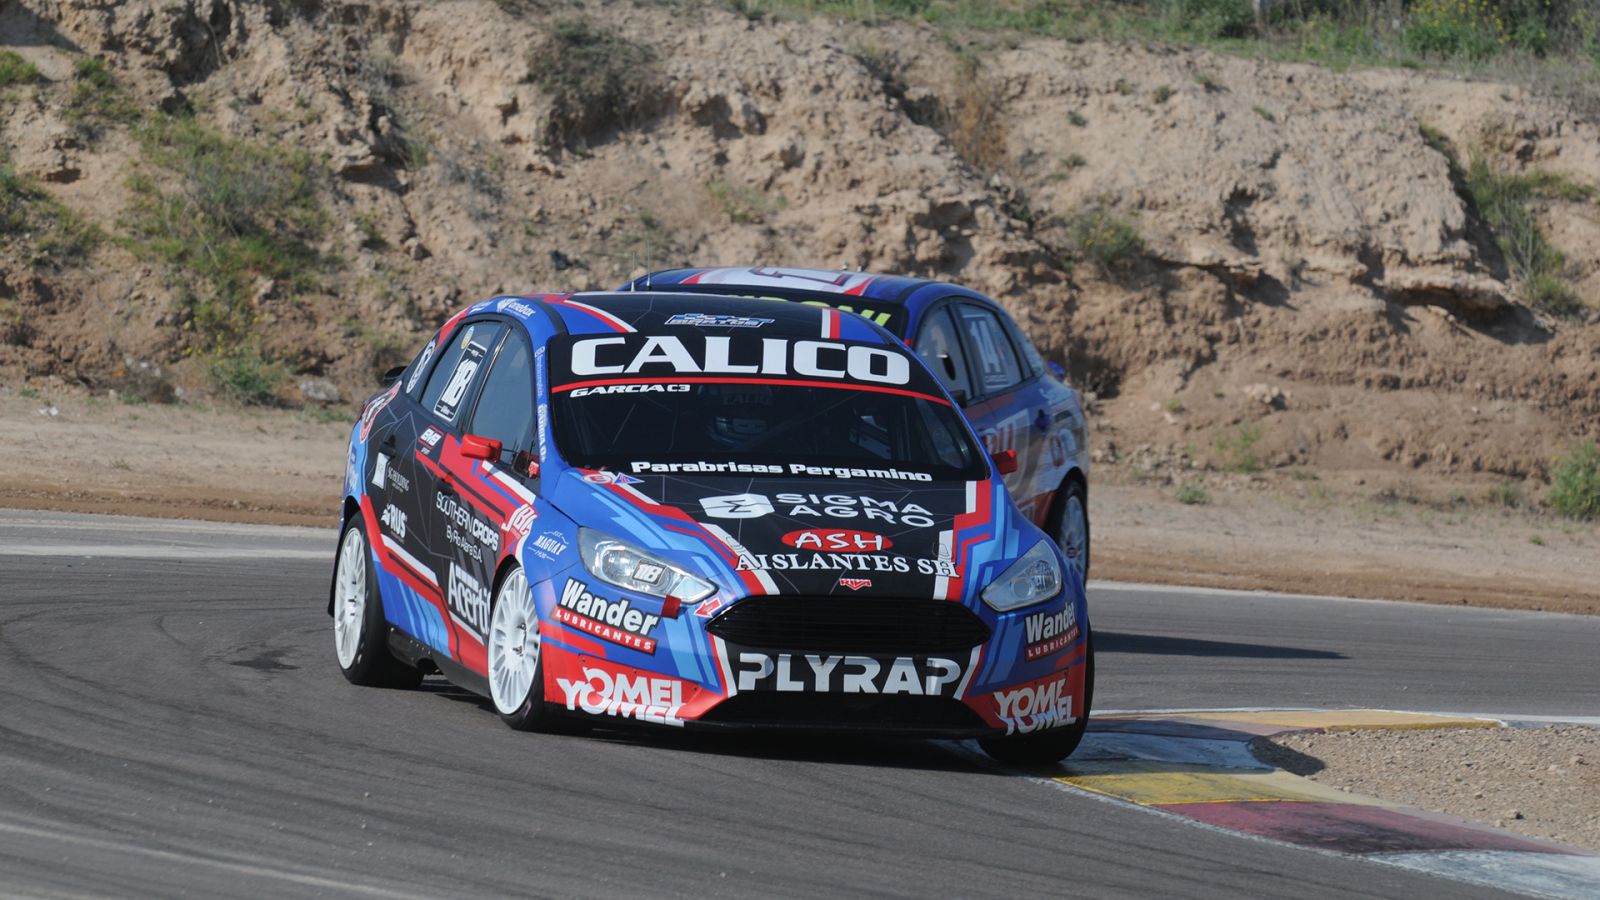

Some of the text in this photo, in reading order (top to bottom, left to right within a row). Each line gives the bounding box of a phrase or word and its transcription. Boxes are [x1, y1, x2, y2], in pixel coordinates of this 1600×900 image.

[570, 335, 910, 386] CALICO
[441, 359, 478, 407] 18
[569, 384, 665, 398] GARCIA
[631, 461, 933, 482] Parabrisas Pergamino
[775, 493, 934, 516] SIGMA
[788, 504, 935, 528] AGRO
[795, 530, 883, 551] ASH
[633, 563, 664, 583] 18
[735, 552, 910, 573] AISLANTES
[560, 576, 660, 637] Wander
[555, 609, 653, 653] LUBRICANTES
[738, 652, 961, 696] PLYRAP
